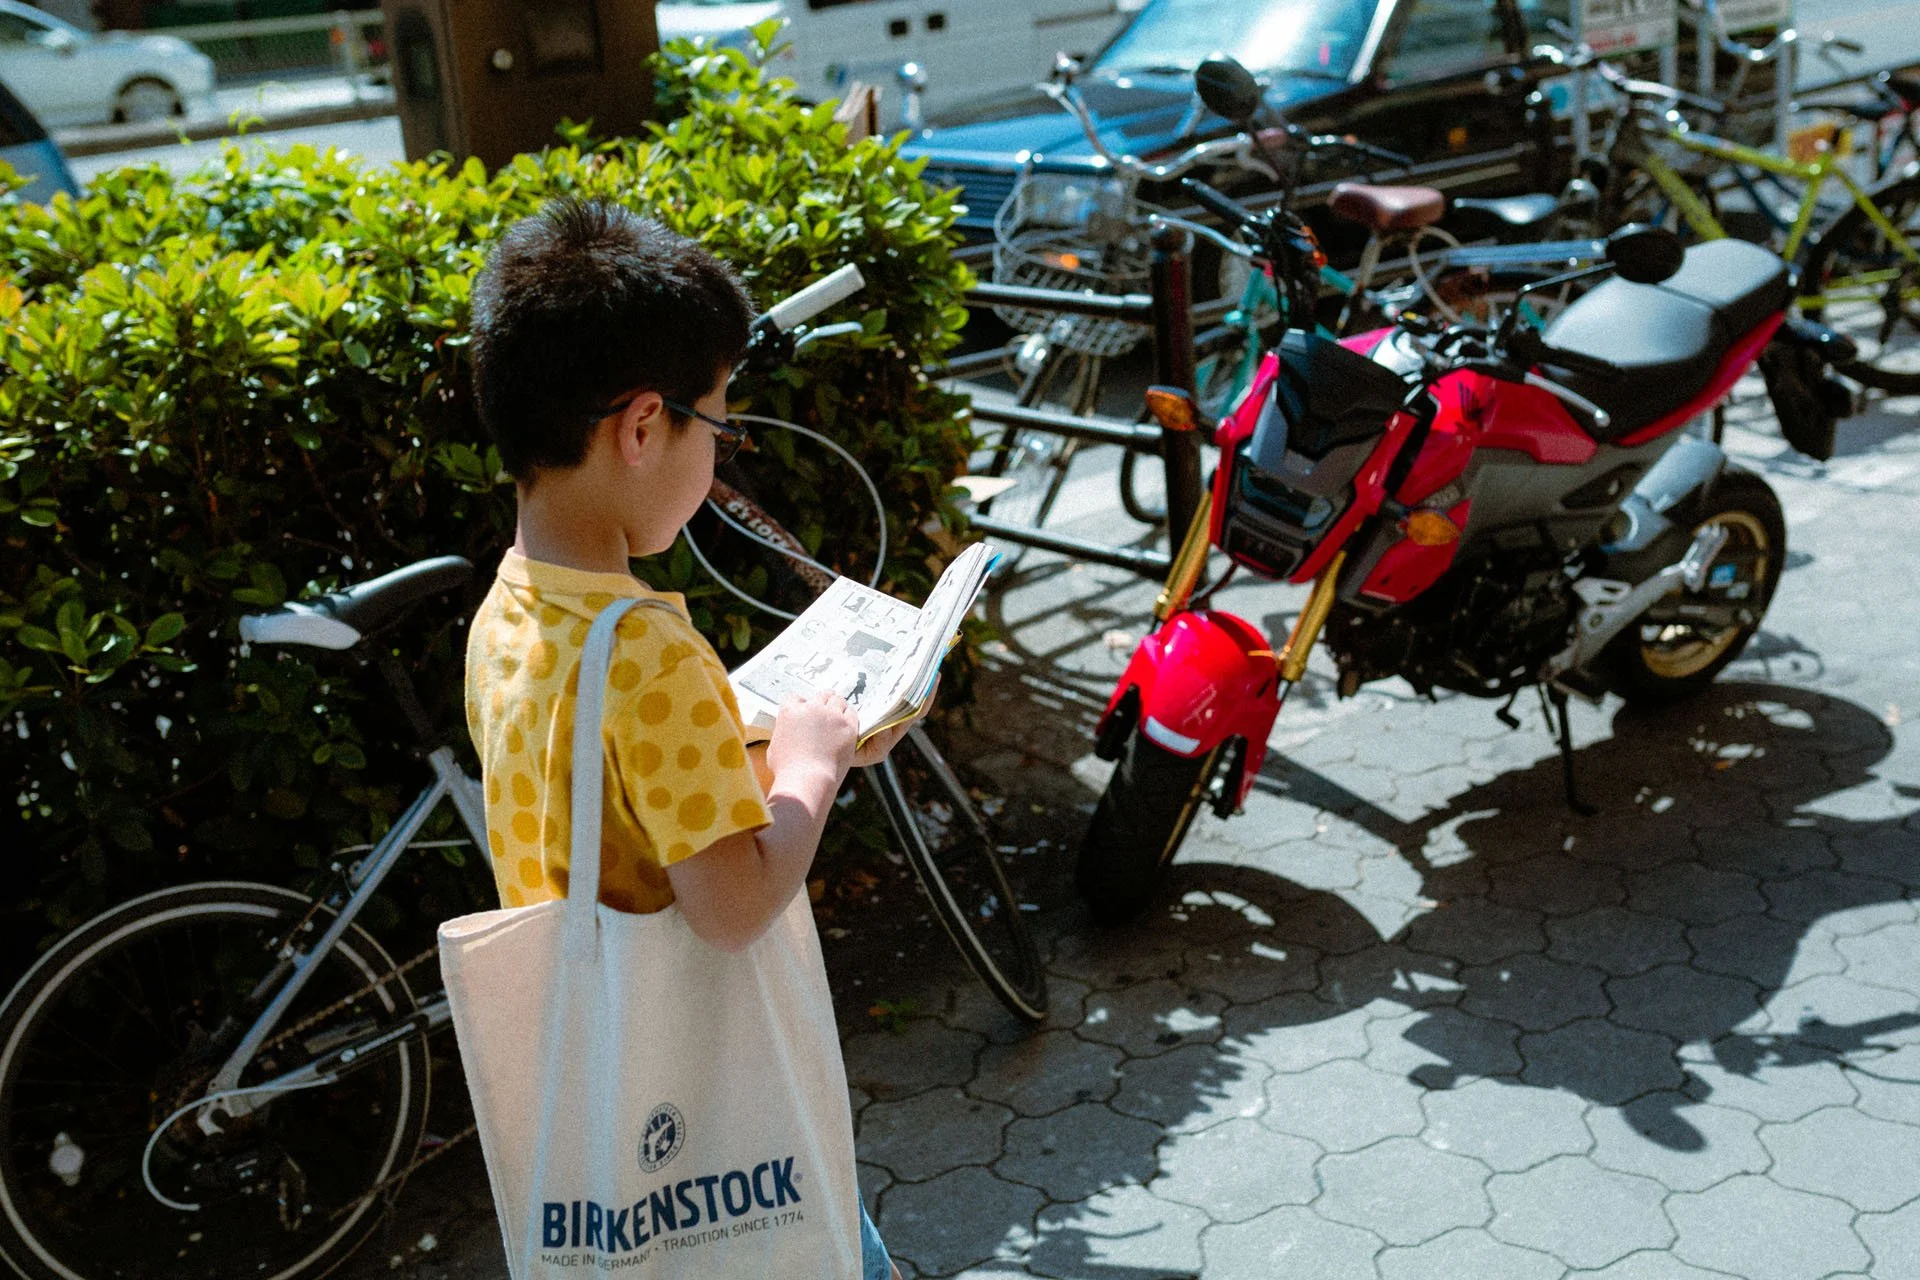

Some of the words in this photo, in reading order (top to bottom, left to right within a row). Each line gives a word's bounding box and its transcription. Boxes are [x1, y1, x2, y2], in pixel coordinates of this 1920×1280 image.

[541, 1253, 579, 1267] MADE
[582, 1253, 596, 1266] IN
[662, 1228, 729, 1252] TRADITION
[732, 1218, 770, 1238] SINCE
[774, 1211, 804, 1227] 1774
[543, 1156, 801, 1253] BIRKENSTOCK
